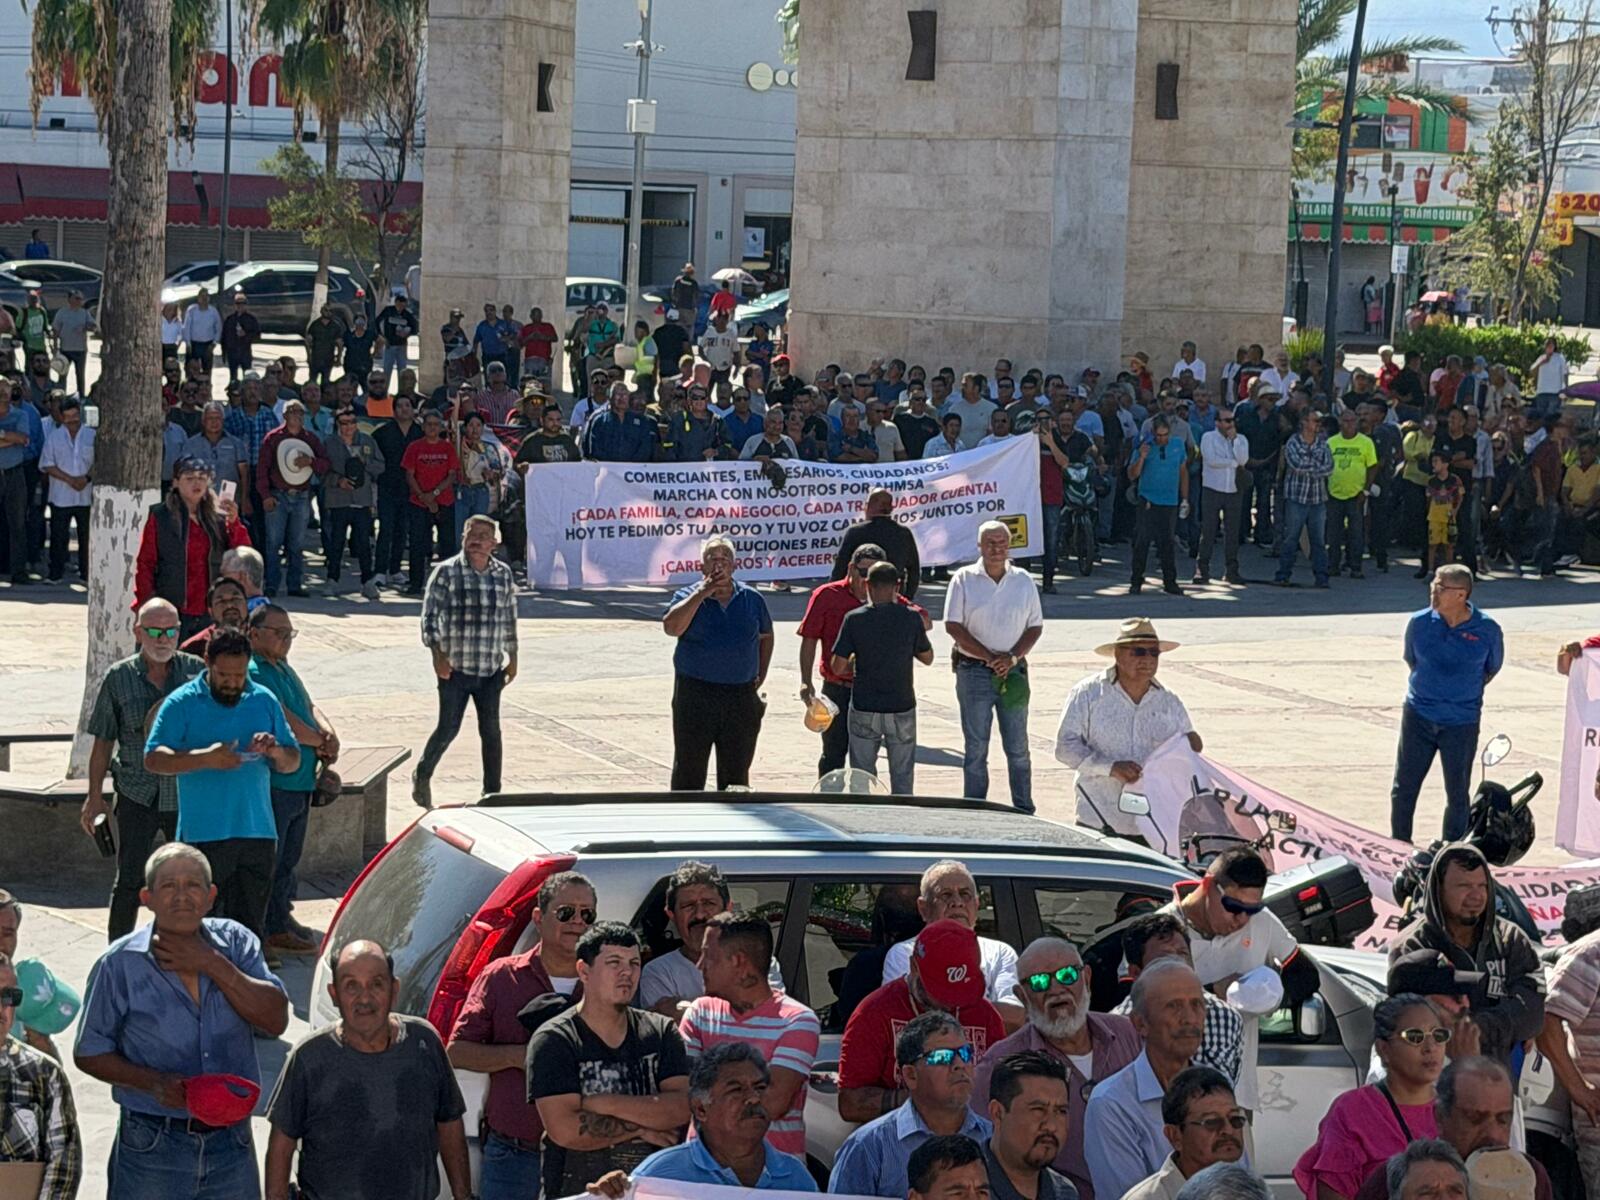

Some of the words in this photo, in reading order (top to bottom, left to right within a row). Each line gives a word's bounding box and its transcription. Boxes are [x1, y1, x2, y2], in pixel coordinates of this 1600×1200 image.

[624, 470, 740, 484] COMERCIANTES,
[744, 466, 848, 482] EMESARIOS,
[653, 489, 718, 501] MARCHA
[721, 487, 752, 500] CON
[757, 483, 836, 499] NOSOTROS
[840, 483, 870, 496] POR
[875, 479, 924, 491] AHMSA
[572, 507, 616, 524] ¡CADA
[620, 506, 681, 520] FAMILIA,
[684, 506, 726, 519] CADA
[730, 504, 800, 518] NEGOCIO,
[804, 502, 843, 515] CADA
[941, 481, 998, 500] CUENTA!
[565, 527, 596, 541] HOY
[598, 525, 615, 539] TE
[619, 523, 684, 538] PEDIMOS
[687, 523, 706, 535] TU
[709, 523, 762, 536] APOYO
[765, 523, 776, 535] Y
[777, 522, 796, 534] TU
[799, 520, 829, 533] VOZ
[919, 502, 974, 520] JUNTOS
[977, 498, 1006, 513] POR
[766, 556, 777, 568] Y
